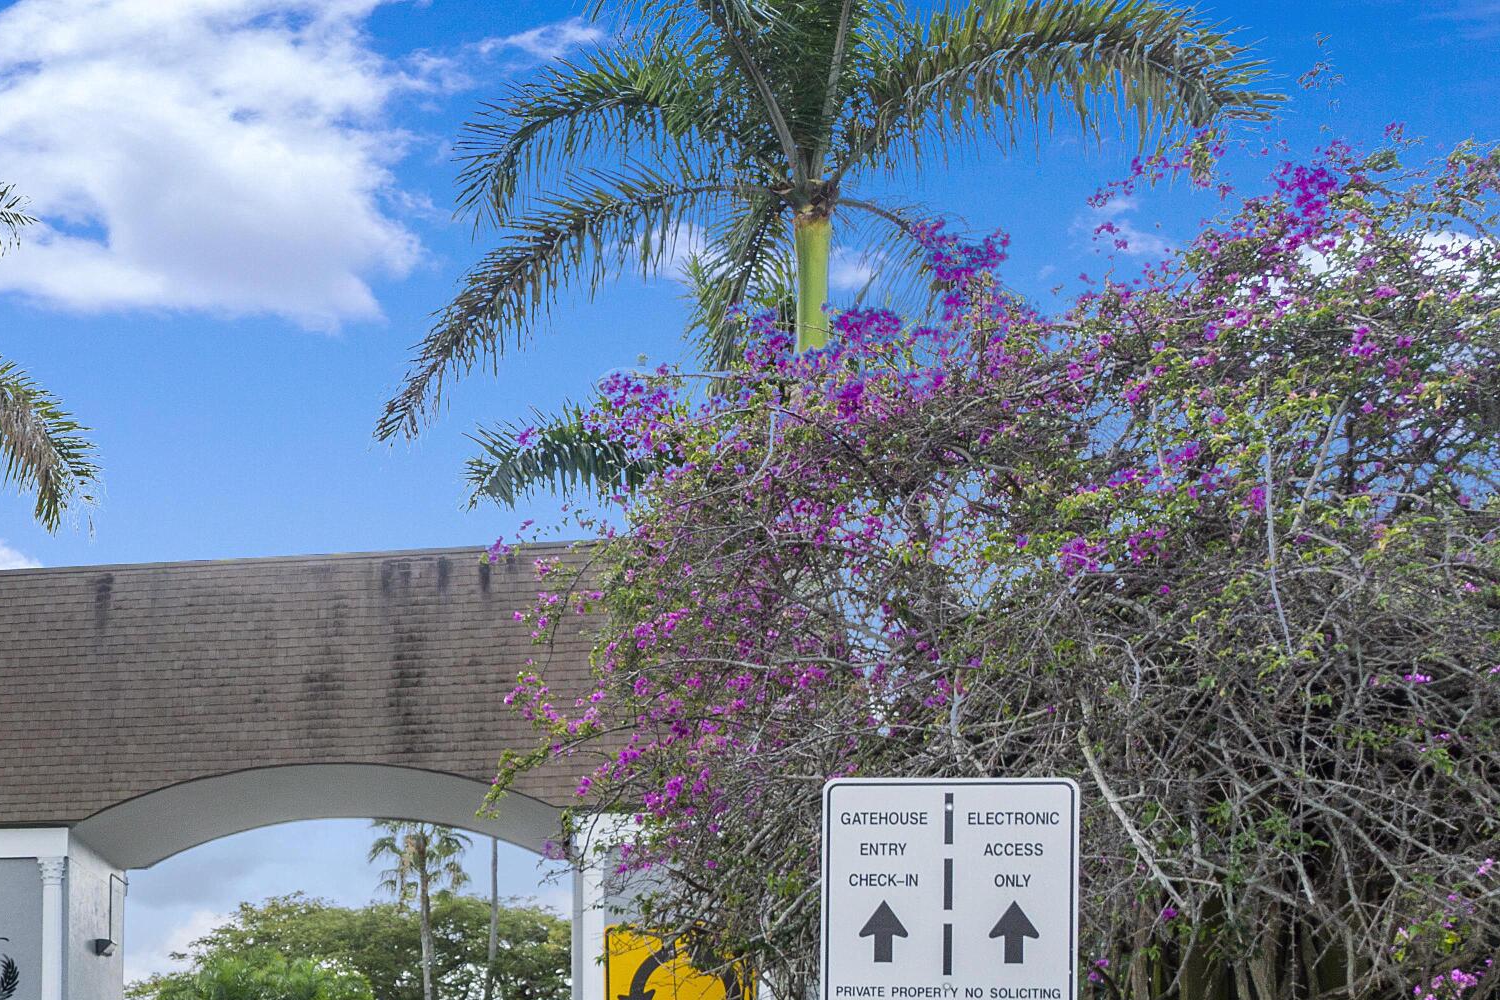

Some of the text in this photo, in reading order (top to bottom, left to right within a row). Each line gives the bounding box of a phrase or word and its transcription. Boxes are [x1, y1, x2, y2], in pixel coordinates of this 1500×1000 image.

[840, 812, 928, 825] GATEHOUSE
[967, 812, 1060, 825] ELECTRONIC
[860, 843, 907, 856] ENTRY
[983, 843, 1044, 857] ACCESS
[849, 874, 919, 887] CHECK-IN
[994, 874, 1032, 888] ONLY
[835, 986, 1061, 1000] PRIVATE PROPERTY NO SOLICITING
